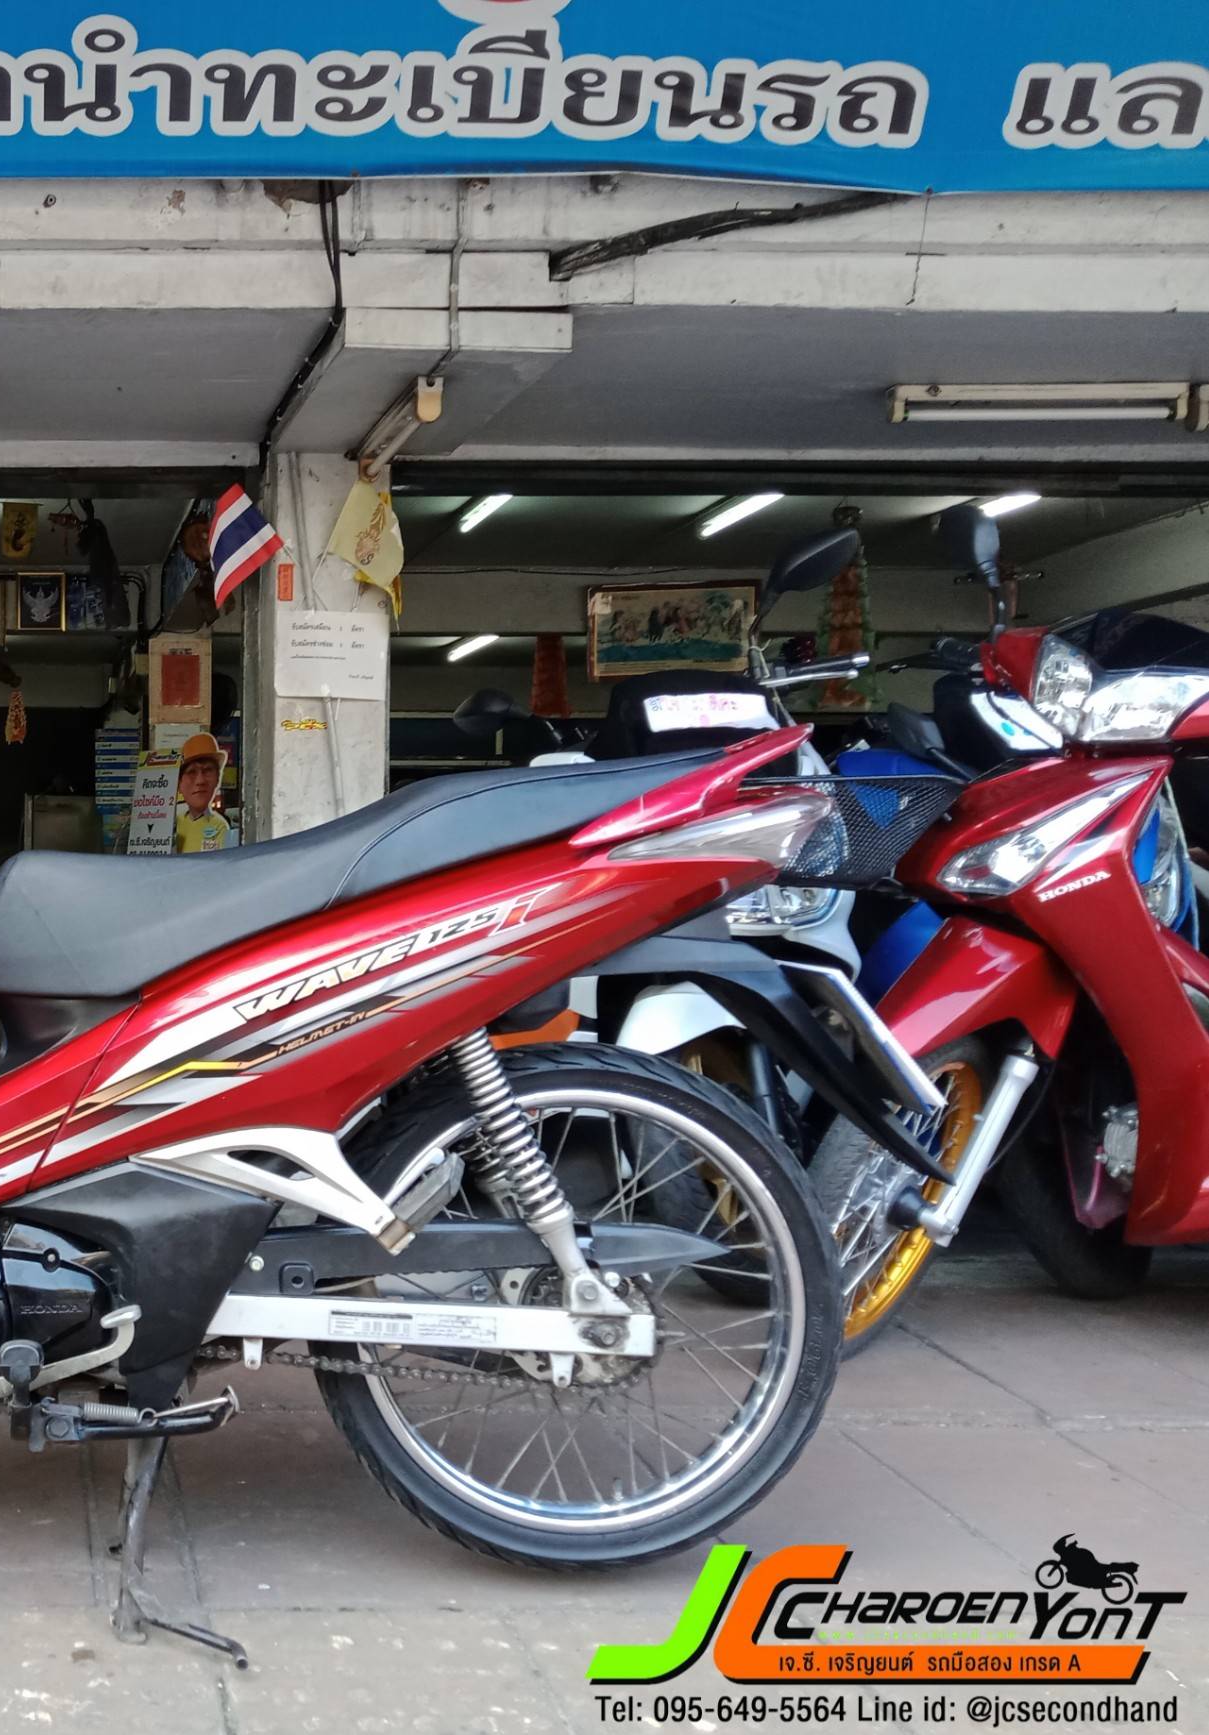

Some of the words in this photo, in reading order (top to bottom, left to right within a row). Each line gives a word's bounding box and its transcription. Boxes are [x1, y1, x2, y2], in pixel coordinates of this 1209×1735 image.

[168, 797, 175, 807] 2
[1037, 870, 1112, 902] HONDA
[233, 933, 422, 1022] WAVE
[278, 1011, 368, 1056] HELMET-IN
[19, 1303, 83, 1315] HONDA
